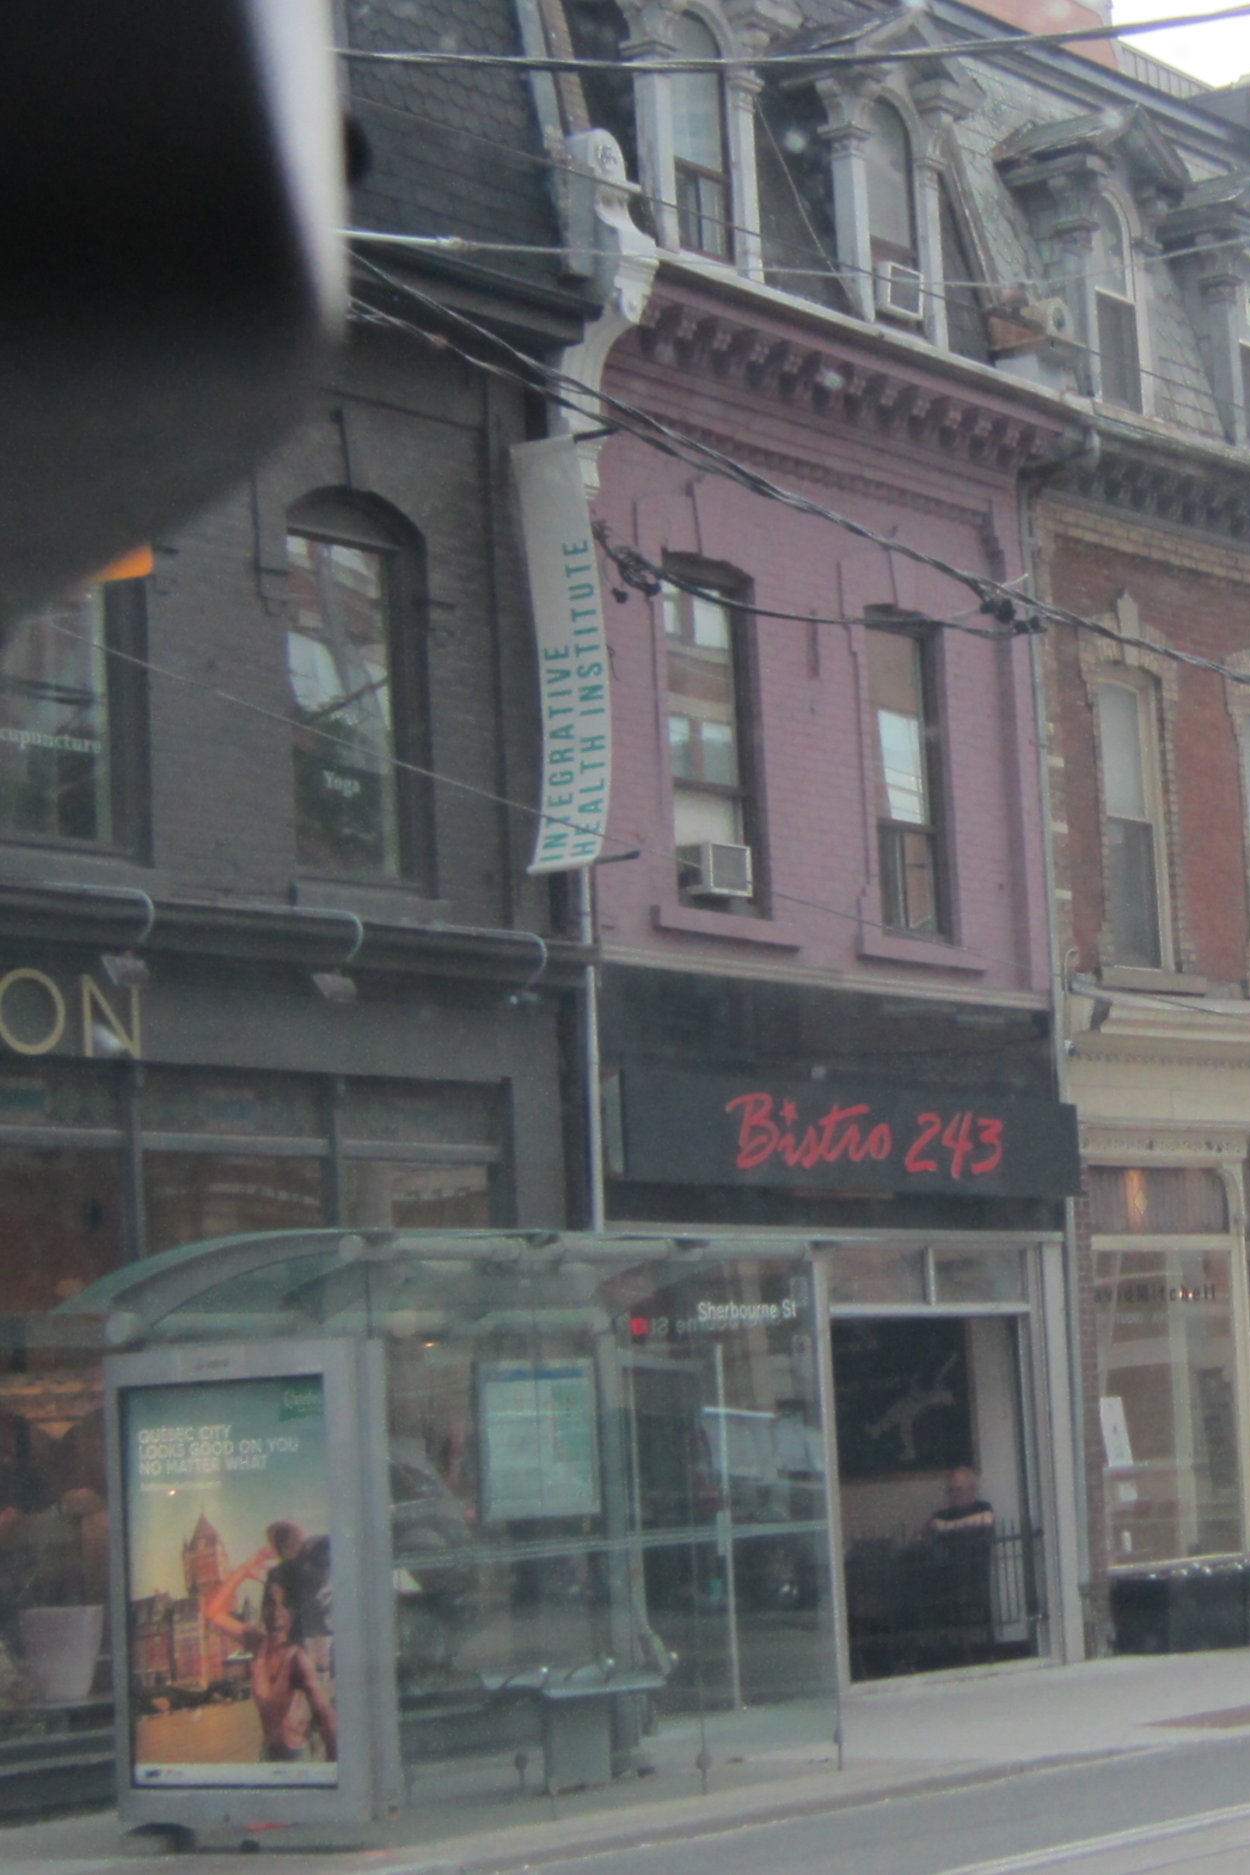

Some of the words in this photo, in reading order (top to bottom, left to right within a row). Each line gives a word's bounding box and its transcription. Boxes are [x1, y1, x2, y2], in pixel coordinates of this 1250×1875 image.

[562, 538, 606, 716] INSTITUTE
[540, 644, 573, 862] INTEGRATIVE
[571, 733, 606, 858] HEALTH
[725, 1092, 892, 1169] Bistro
[904, 1111, 1004, 1179] 243
[697, 1301, 778, 1321] Sherbourne
[781, 1298, 798, 1318] St
[189, 1440, 235, 1456] GOOD
[239, 1438, 263, 1454] ON
[267, 1436, 300, 1453] YOU
[199, 1423, 232, 1441] CITY
[138, 1459, 163, 1476] NO
[224, 1453, 267, 1471] WHAT
